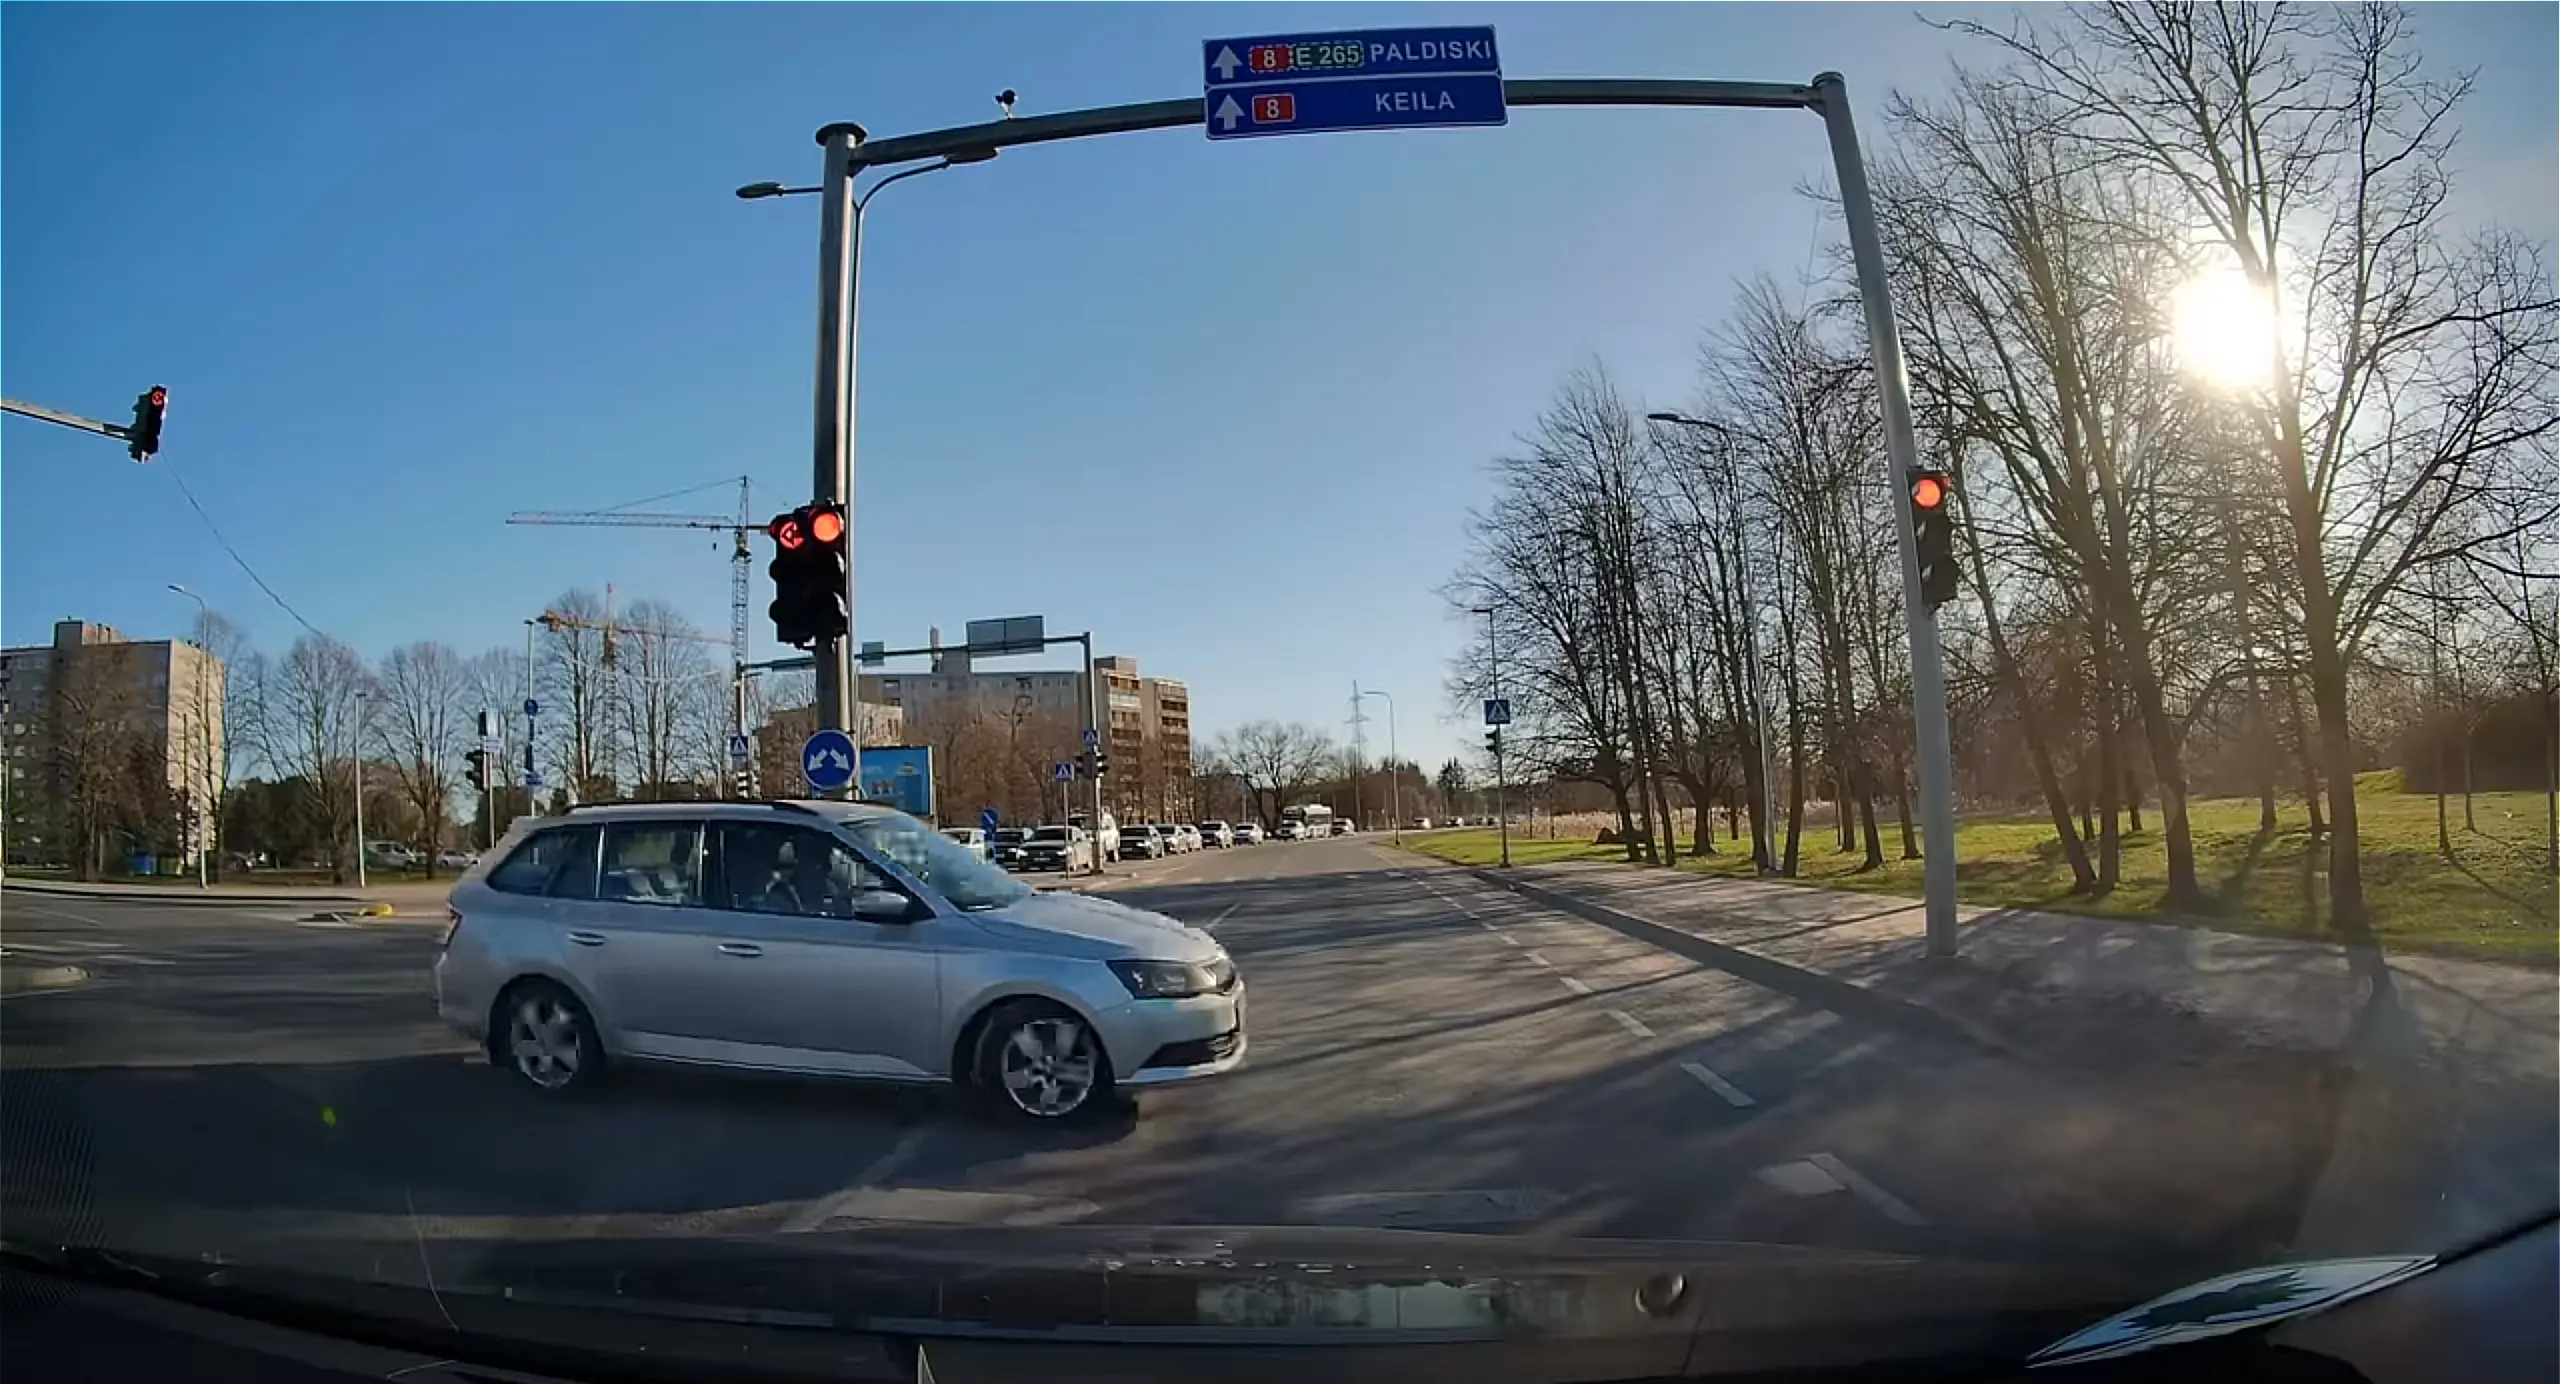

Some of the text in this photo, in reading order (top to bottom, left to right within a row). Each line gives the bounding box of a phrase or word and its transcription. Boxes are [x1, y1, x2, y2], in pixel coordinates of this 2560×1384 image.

[1263, 40, 1492, 69] 8 E 265 PALDISKI
[1267, 91, 1456, 119] 8 KEILA
